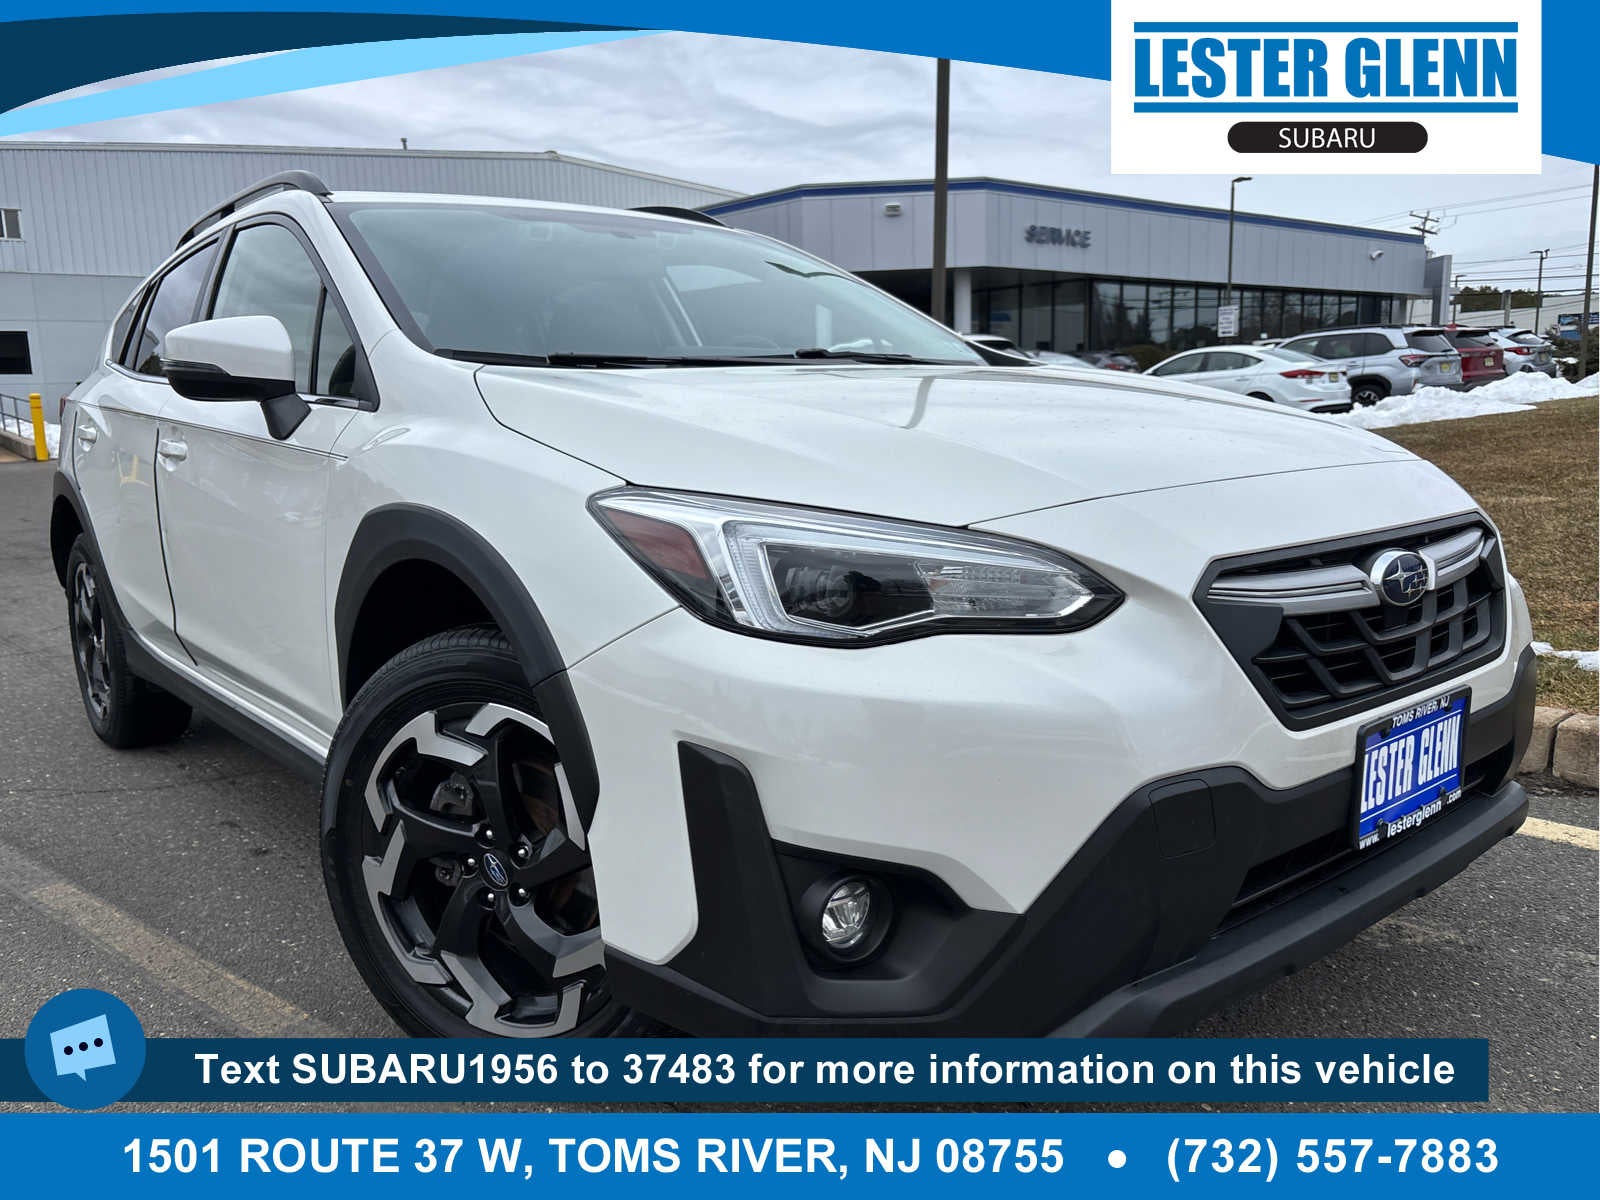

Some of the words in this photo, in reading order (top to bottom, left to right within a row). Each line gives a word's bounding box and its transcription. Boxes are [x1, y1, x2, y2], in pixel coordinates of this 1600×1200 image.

[1025, 225, 1092, 248] SERVICE
[1392, 713, 1414, 728] TOMS
[1440, 695, 1450, 711] NJ
[1360, 735, 1416, 814] LESTER
[1418, 714, 1461, 785] GLENN
[1387, 803, 1442, 838] lesterglenn
